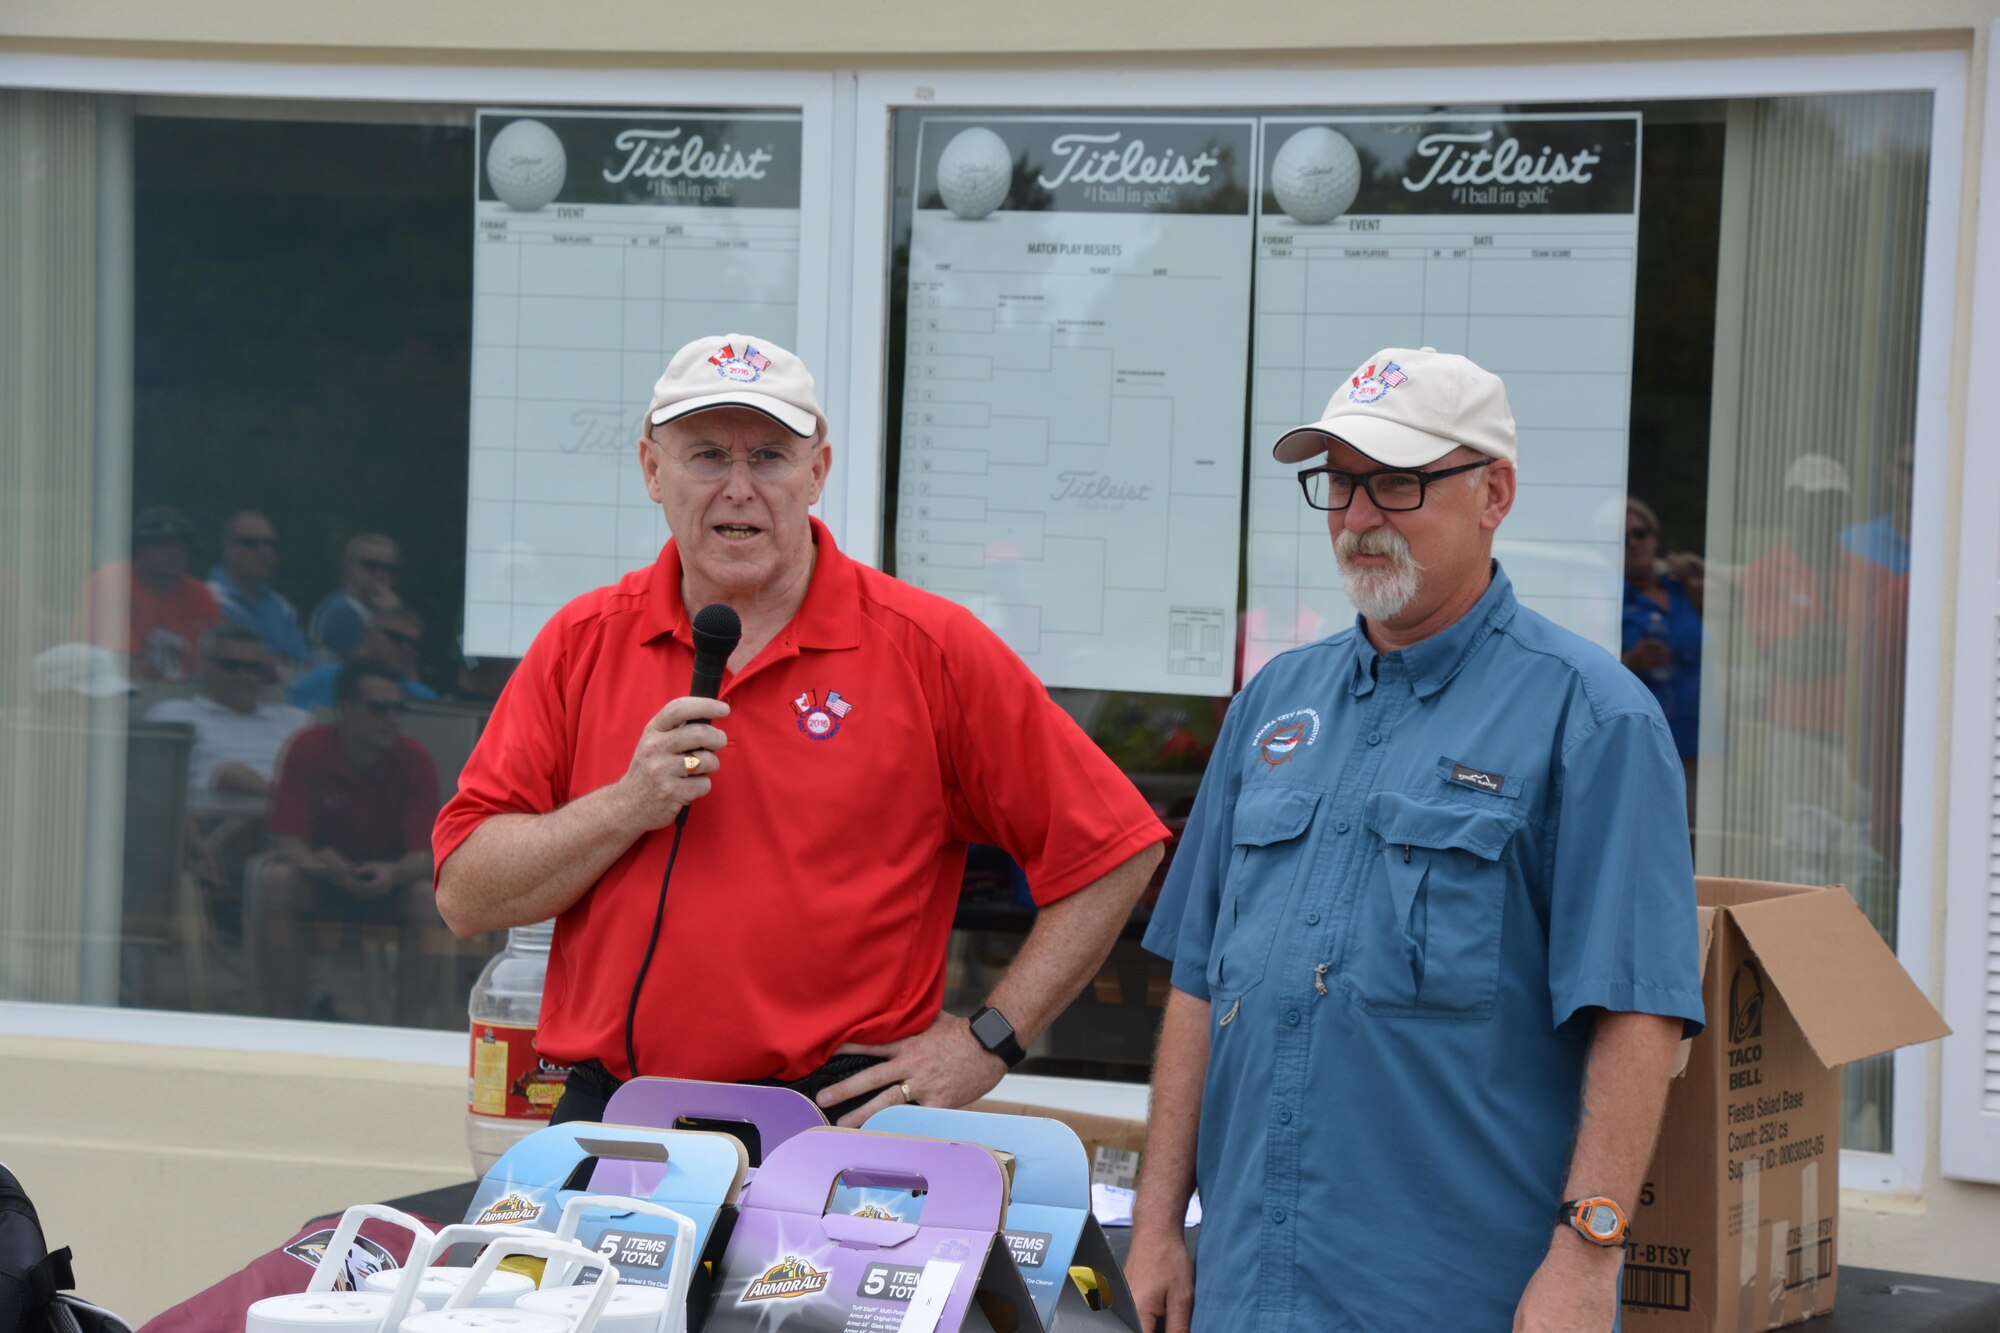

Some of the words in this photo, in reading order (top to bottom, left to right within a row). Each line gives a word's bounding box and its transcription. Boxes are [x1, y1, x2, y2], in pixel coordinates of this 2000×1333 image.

[602, 126, 773, 184] Titleist
[1038, 131, 1218, 190] Titleist
[1402, 128, 1600, 193] Titleist
[1099, 186, 1125, 203] ball
[1127, 187, 1140, 203] in
[1469, 187, 1498, 204] ball
[1500, 188, 1515, 204] in
[557, 207, 585, 219] EVENT
[666, 226, 683, 236] DATE
[1349, 219, 1380, 231] EVENT
[1262, 236, 1293, 245] FORMAT
[1473, 237, 1493, 246] DATE
[1028, 243, 1058, 255] MATCH
[1060, 244, 1081, 256] PLAY
[1084, 244, 1122, 256] RESULTS
[729, 366, 749, 376] 2016
[1049, 470, 1152, 501] Titleist
[808, 719, 828, 729] 2016
[1728, 1044, 1762, 1068] TACO
[1729, 1068, 1762, 1091] BELL
[1728, 1102, 1755, 1125] Fiesta
[1757, 1093, 1780, 1118] Salad
[1783, 1091, 1804, 1112] Base
[1728, 1128, 1757, 1153] Count:
[1779, 1122, 1788, 1139] cs
[1766, 1148, 1778, 1170] ID:
[1640, 1183, 1655, 1206] 5
[598, 1234, 622, 1259] 5
[625, 1237, 667, 1252] ITEMS
[620, 1251, 659, 1266] TOTAL
[864, 1268, 888, 1295] 5
[889, 1285, 915, 1299] TOT
[873, 1315, 891, 1323] Original
